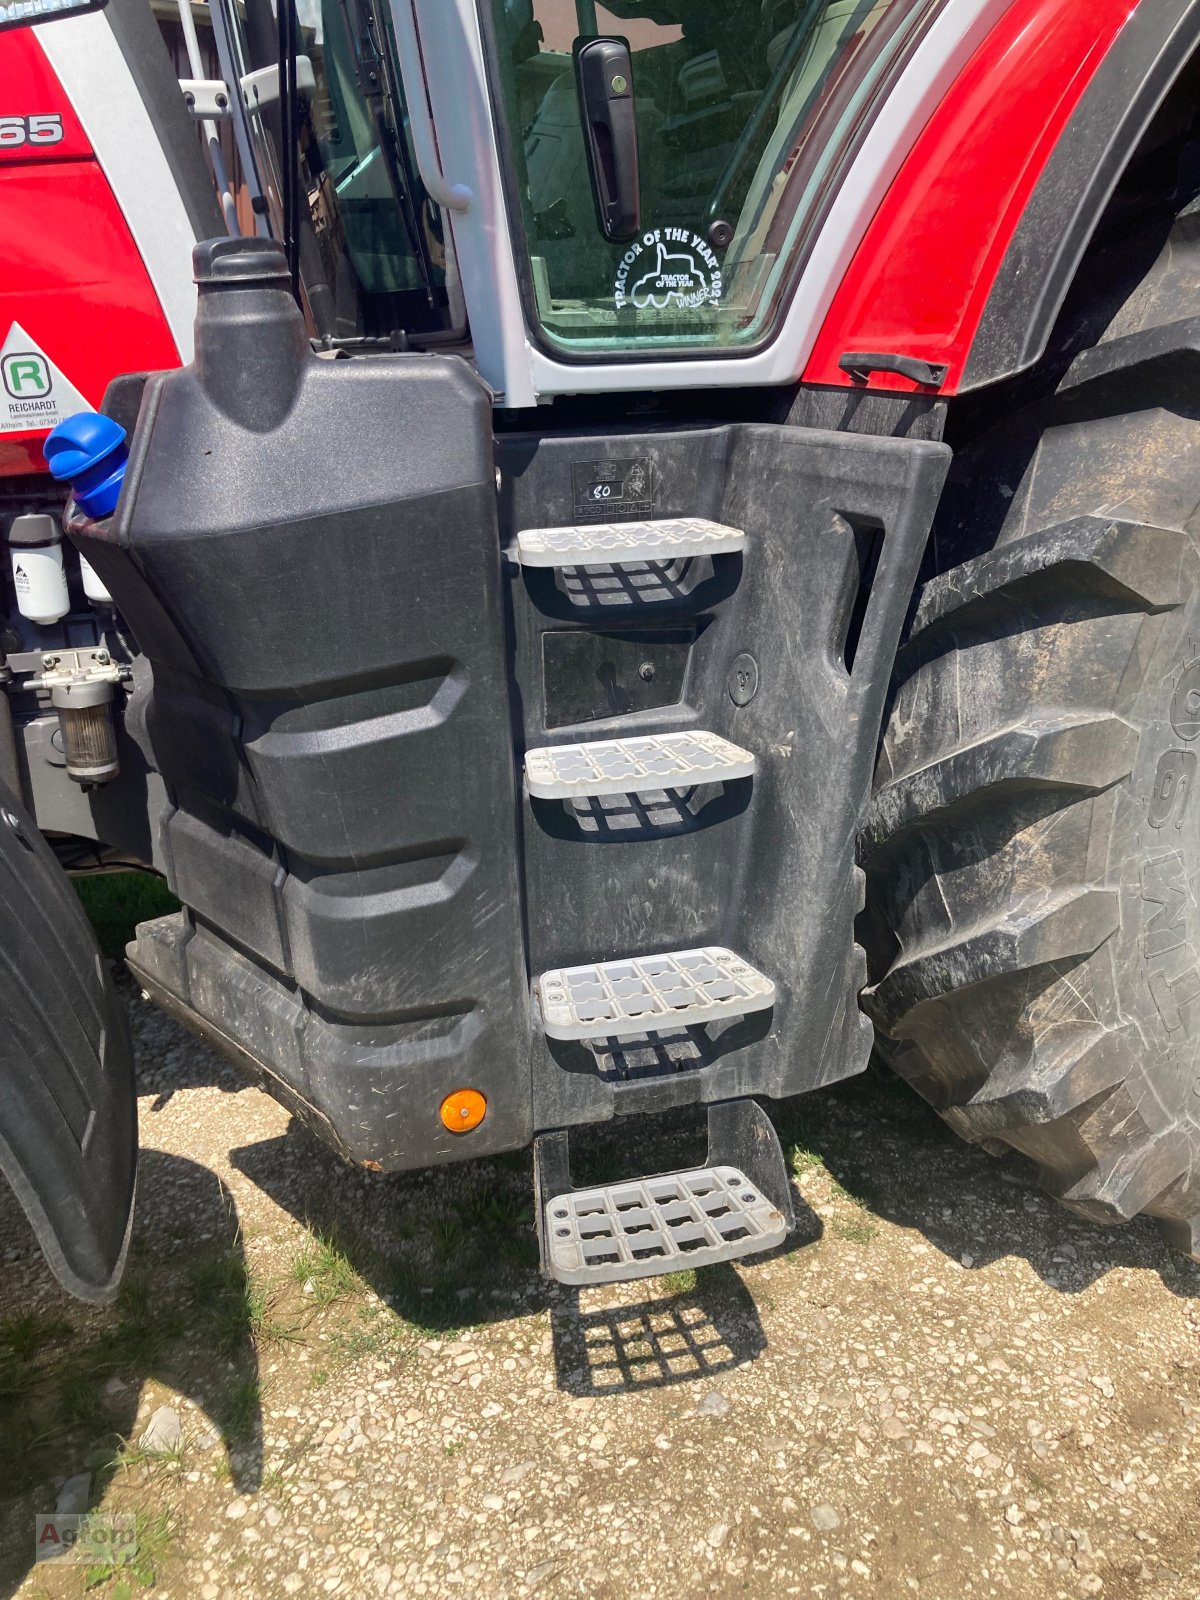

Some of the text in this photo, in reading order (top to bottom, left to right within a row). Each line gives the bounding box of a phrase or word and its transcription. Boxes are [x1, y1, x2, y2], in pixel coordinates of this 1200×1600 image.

[614, 242, 644, 309] TRACTOR
[643, 229, 661, 246] OF
[664, 228, 690, 243] THE
[709, 270, 722, 306] 2021
[655, 280, 665, 288] OF
[665, 280, 678, 288] THE
[676, 287, 712, 309] WINNER
[10, 360, 45, 391] R
[8, 400, 56, 413] REICHARDT
